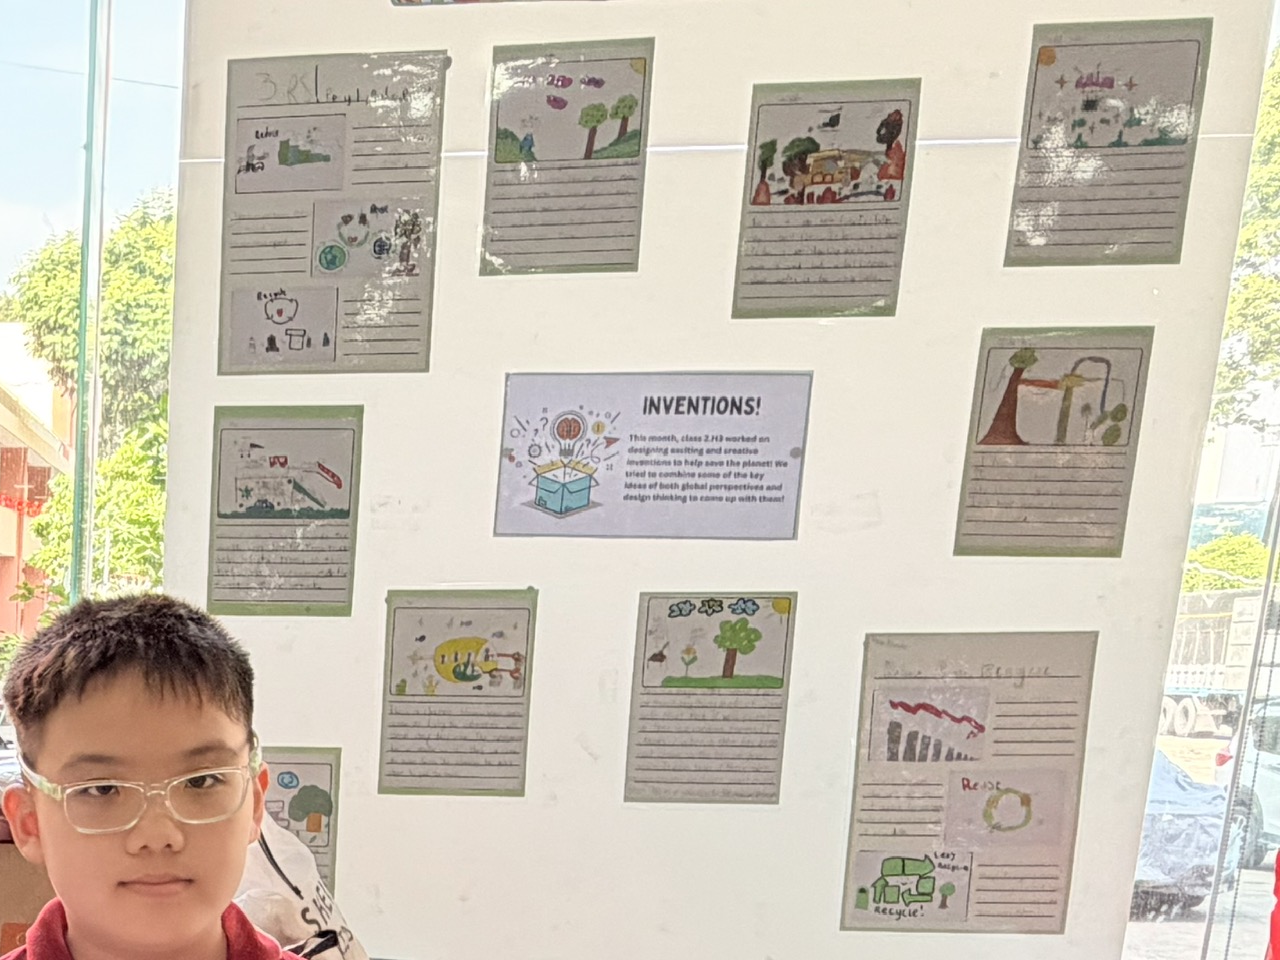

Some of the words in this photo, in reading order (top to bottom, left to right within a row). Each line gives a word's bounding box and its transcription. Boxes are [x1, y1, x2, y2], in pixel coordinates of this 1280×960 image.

[643, 395, 761, 415] INVENTIONS!
[629, 434, 647, 442] This
[681, 434, 702, 442] class
[725, 434, 757, 442] worked
[628, 446, 669, 456] designing
[705, 446, 722, 454] and
[626, 458, 672, 466] inventions
[684, 459, 703, 468] help
[726, 459, 741, 467] the
[625, 470, 646, 478] tried
[648, 481, 658, 489] of
[659, 482, 679, 490] both
[681, 482, 708, 492] global
[766, 483, 782, 491] and
[623, 493, 651, 503] design
[652, 493, 687, 504] thinking
[725, 496, 736, 504] up
[738, 495, 757, 503] with
